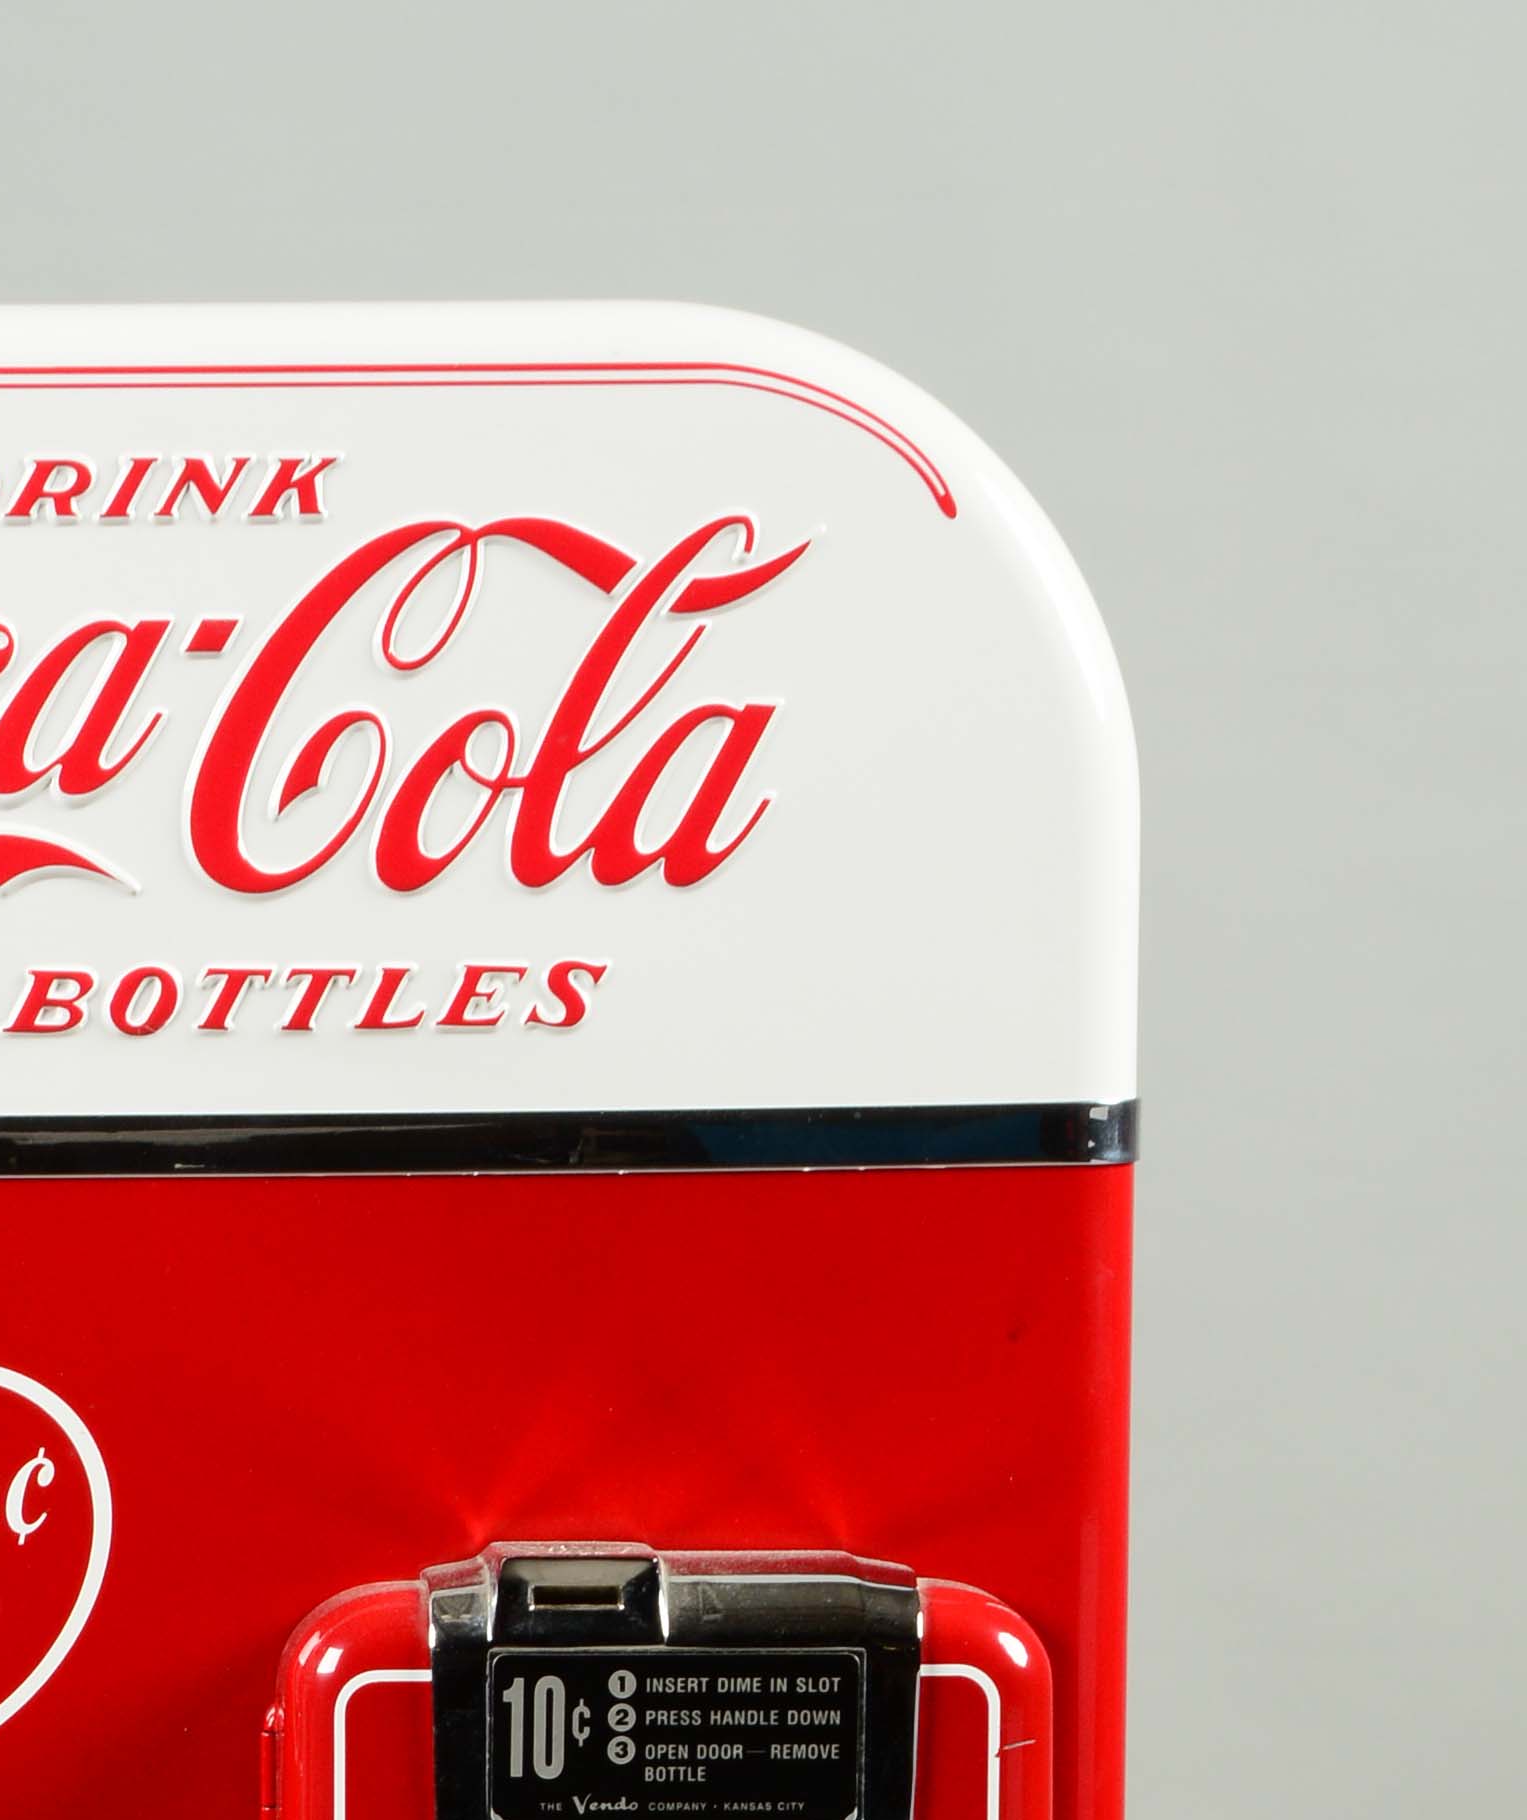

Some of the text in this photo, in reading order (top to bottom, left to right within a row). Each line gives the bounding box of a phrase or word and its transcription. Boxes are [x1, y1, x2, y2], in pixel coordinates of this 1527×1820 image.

[645, 1677, 710, 1694] INSERT
[717, 1677, 763, 1693] DIME
[770, 1677, 788, 1693] IN
[795, 1677, 842, 1693] SLOT
[644, 1710, 703, 1726] PRESS
[709, 1710, 780, 1726] HANDLE
[787, 1710, 842, 1726] DOWN
[644, 1744, 689, 1761] OPEN
[770, 1744, 841, 1760] REMOVE
[643, 1766, 707, 1782] BOTTLE
[540, 1802, 563, 1812] THE
[572, 1793, 639, 1815] Vendo
[647, 1802, 708, 1812] COMPANY
[723, 1802, 773, 1812] KANSAS
[776, 1802, 806, 1812] CITY
